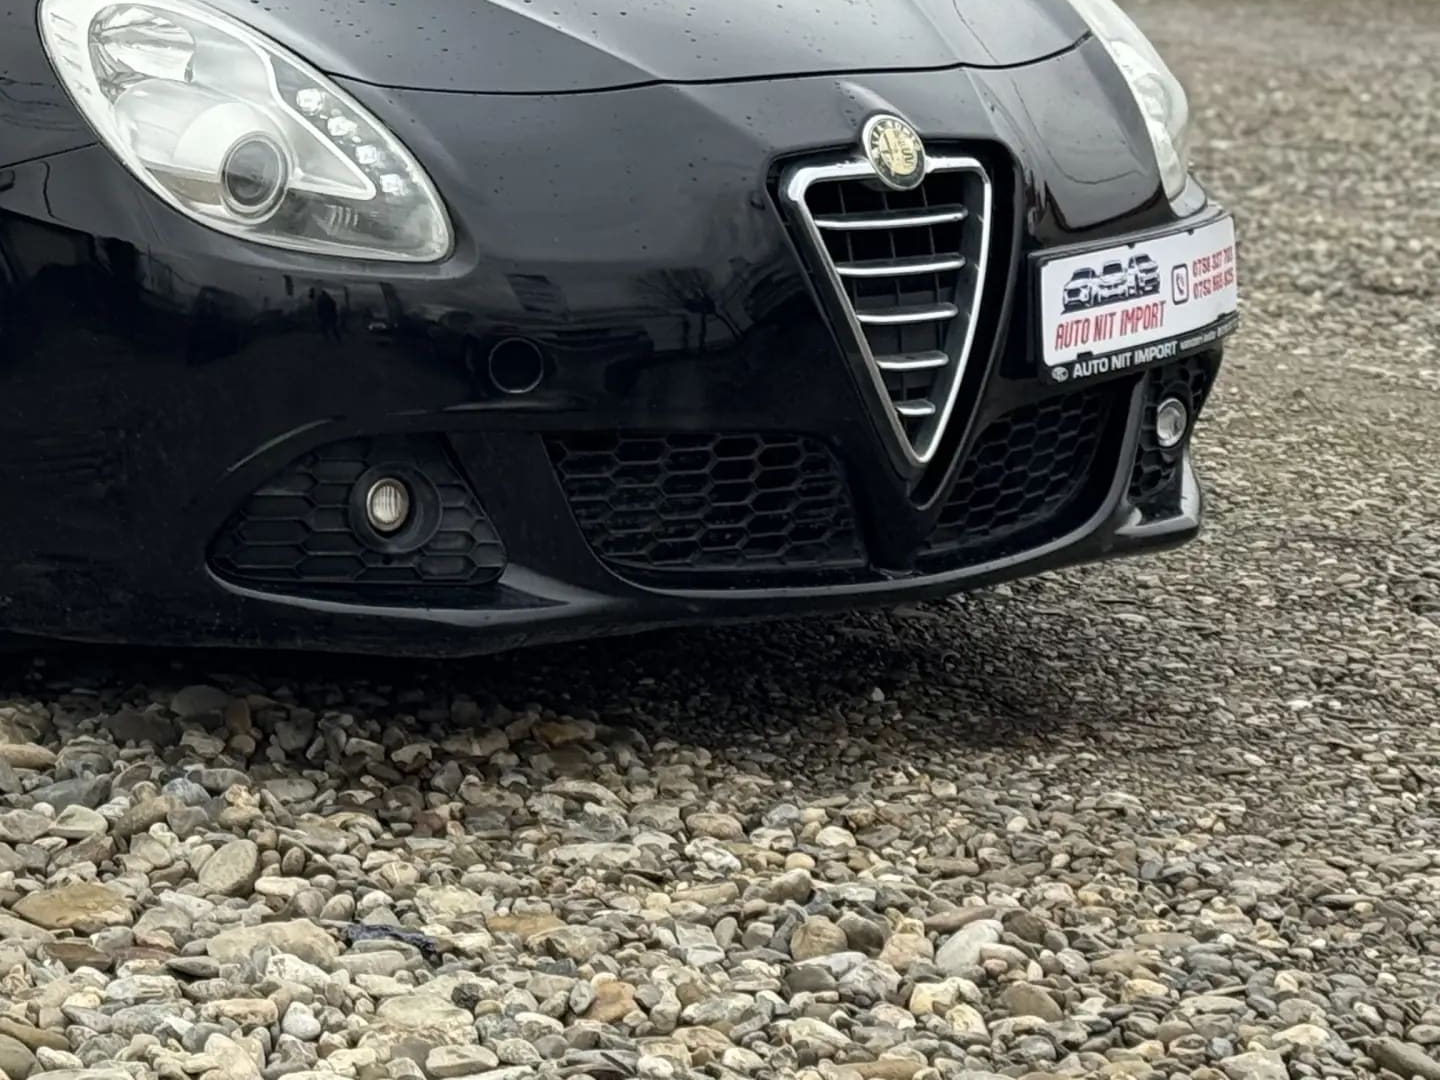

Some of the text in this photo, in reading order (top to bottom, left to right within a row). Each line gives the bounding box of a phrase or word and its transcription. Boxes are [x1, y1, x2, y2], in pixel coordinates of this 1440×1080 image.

[1055, 318, 1090, 351] AUTO
[1093, 312, 1116, 342] NIT
[1120, 301, 1166, 336] IMPORT
[1073, 341, 1178, 379] AUTO NIT IMPORT
